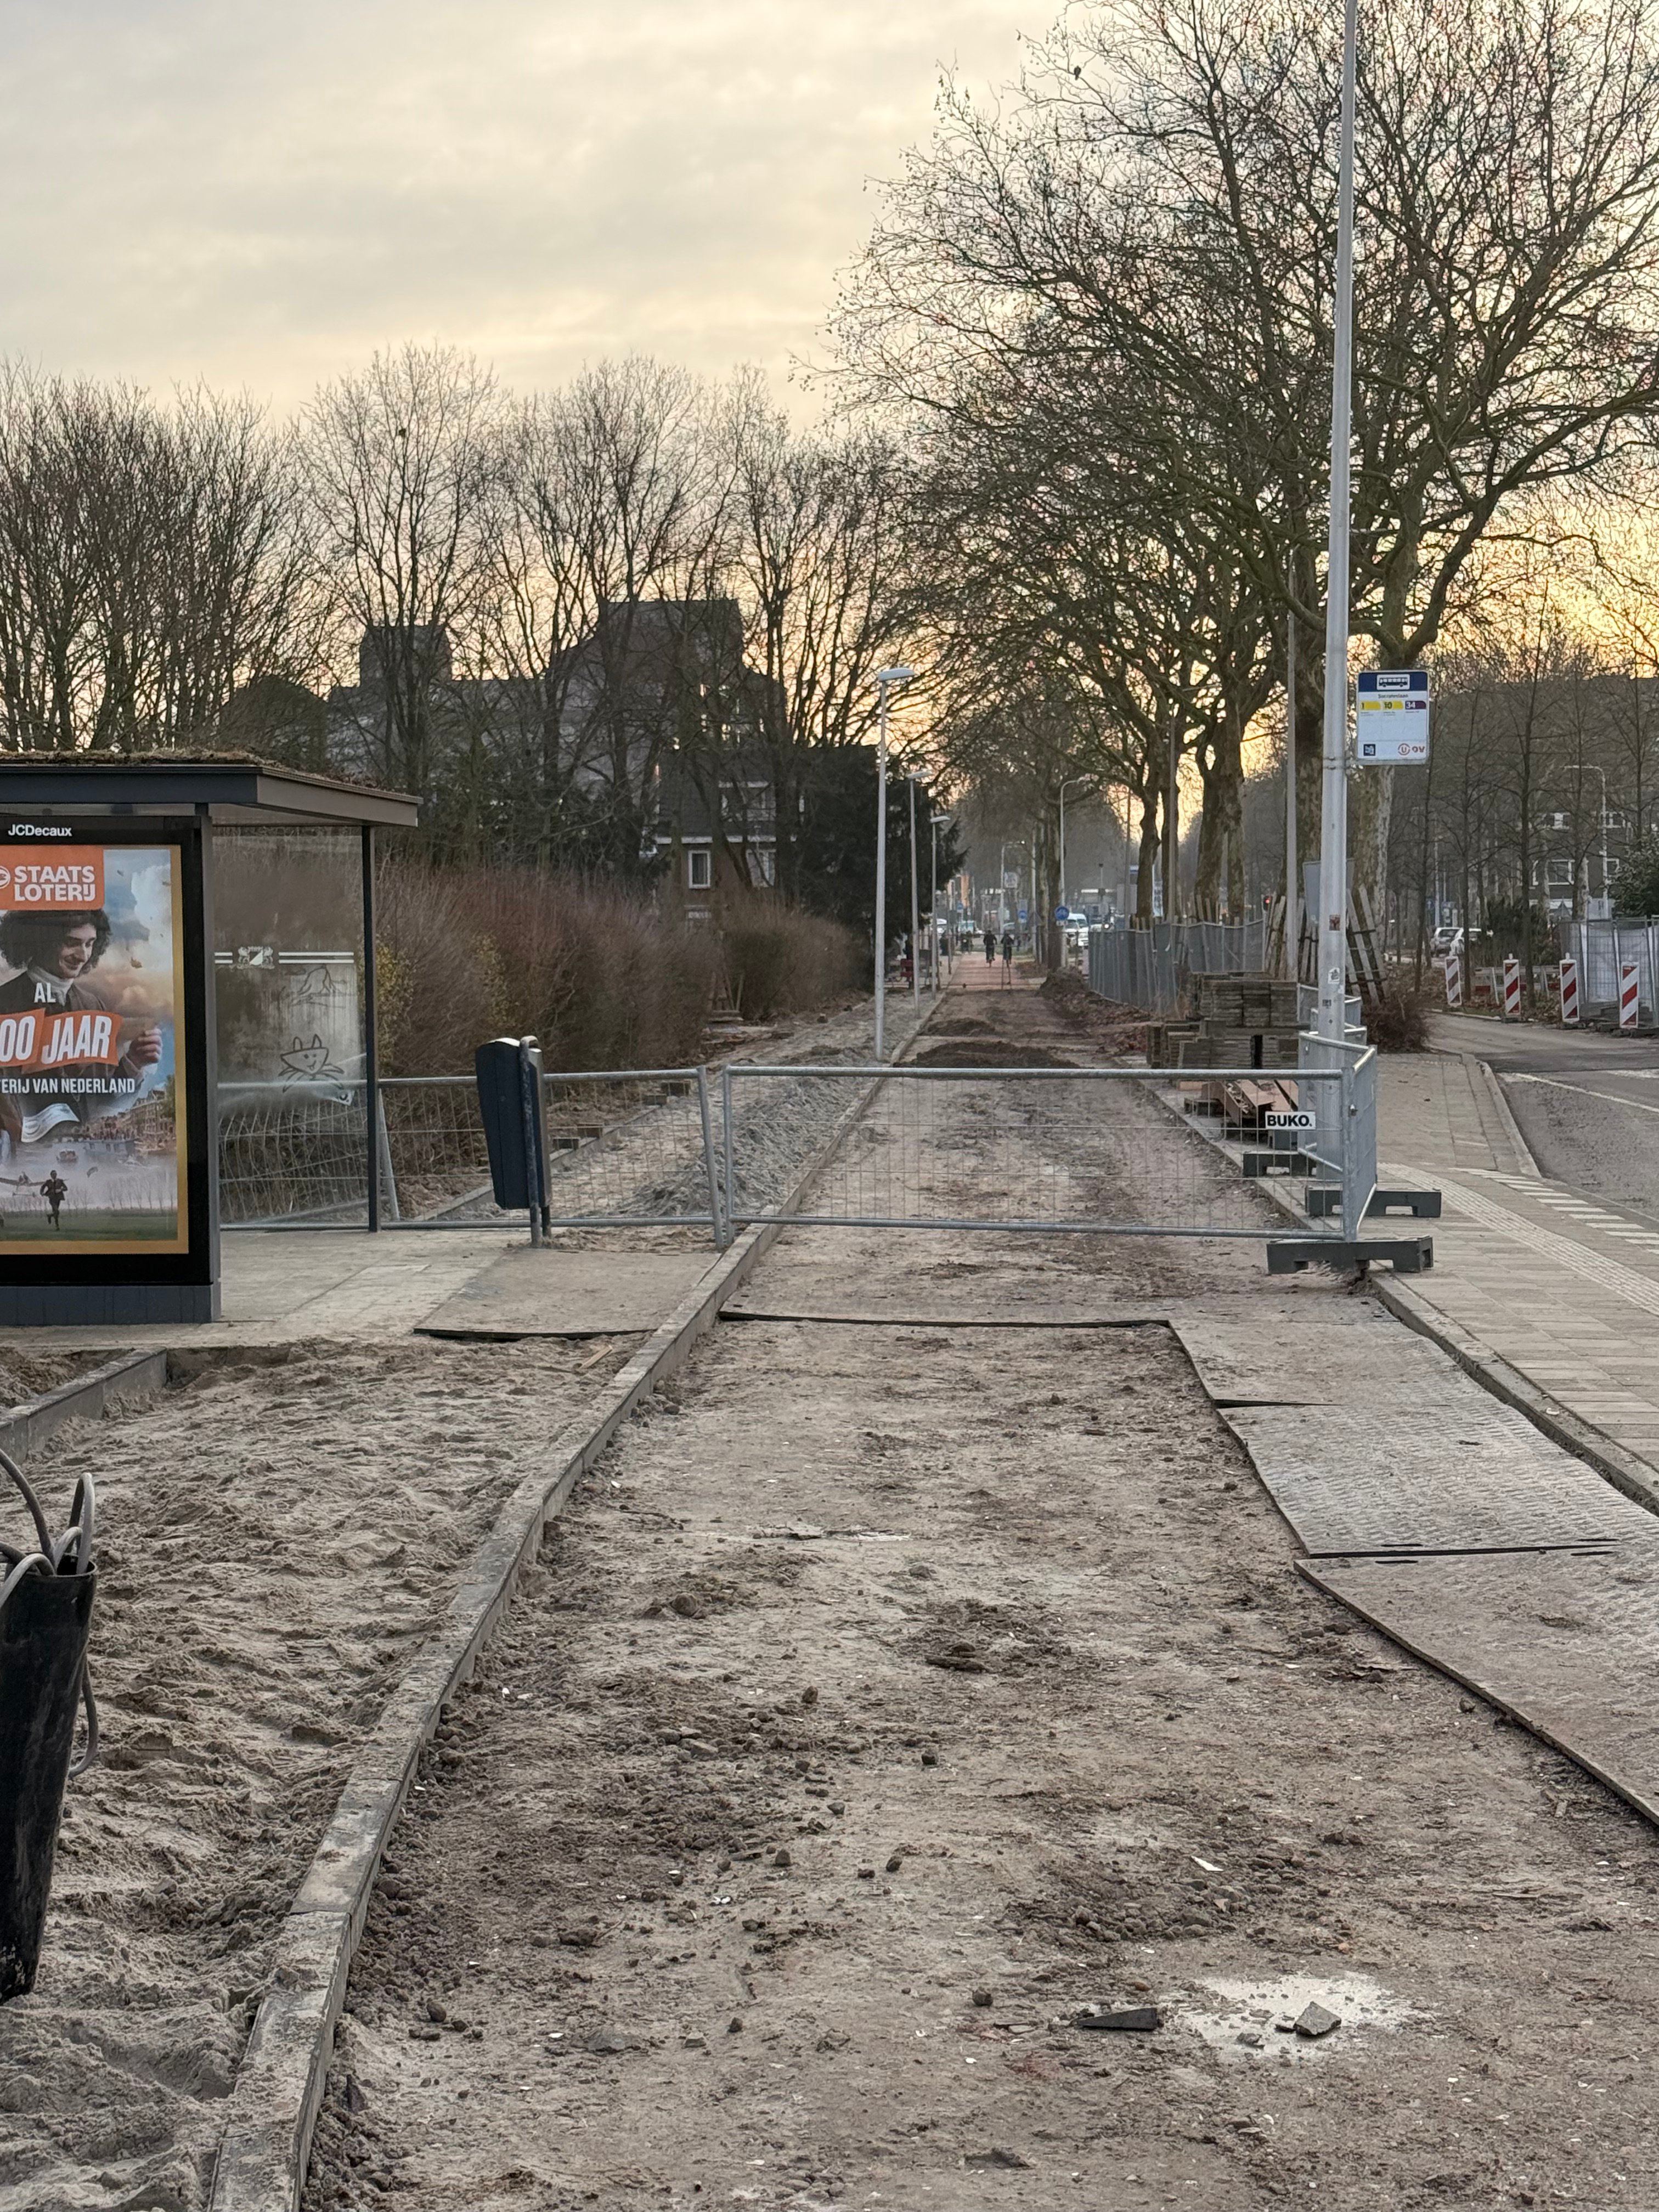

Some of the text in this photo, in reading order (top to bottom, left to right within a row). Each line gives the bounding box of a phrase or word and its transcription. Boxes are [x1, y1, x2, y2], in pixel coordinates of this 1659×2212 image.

[8, 824, 72, 837] JCDecaux
[14, 866, 95, 883] STAATS
[14, 884, 95, 901] LOTERIJ
[34, 983, 56, 1003] AL
[41, 1015, 112, 1064] JAAR
[0, 1078, 136, 1093] ERIJ VAN NEDERLAND
[1267, 1115, 1313, 1127] BUKO.
